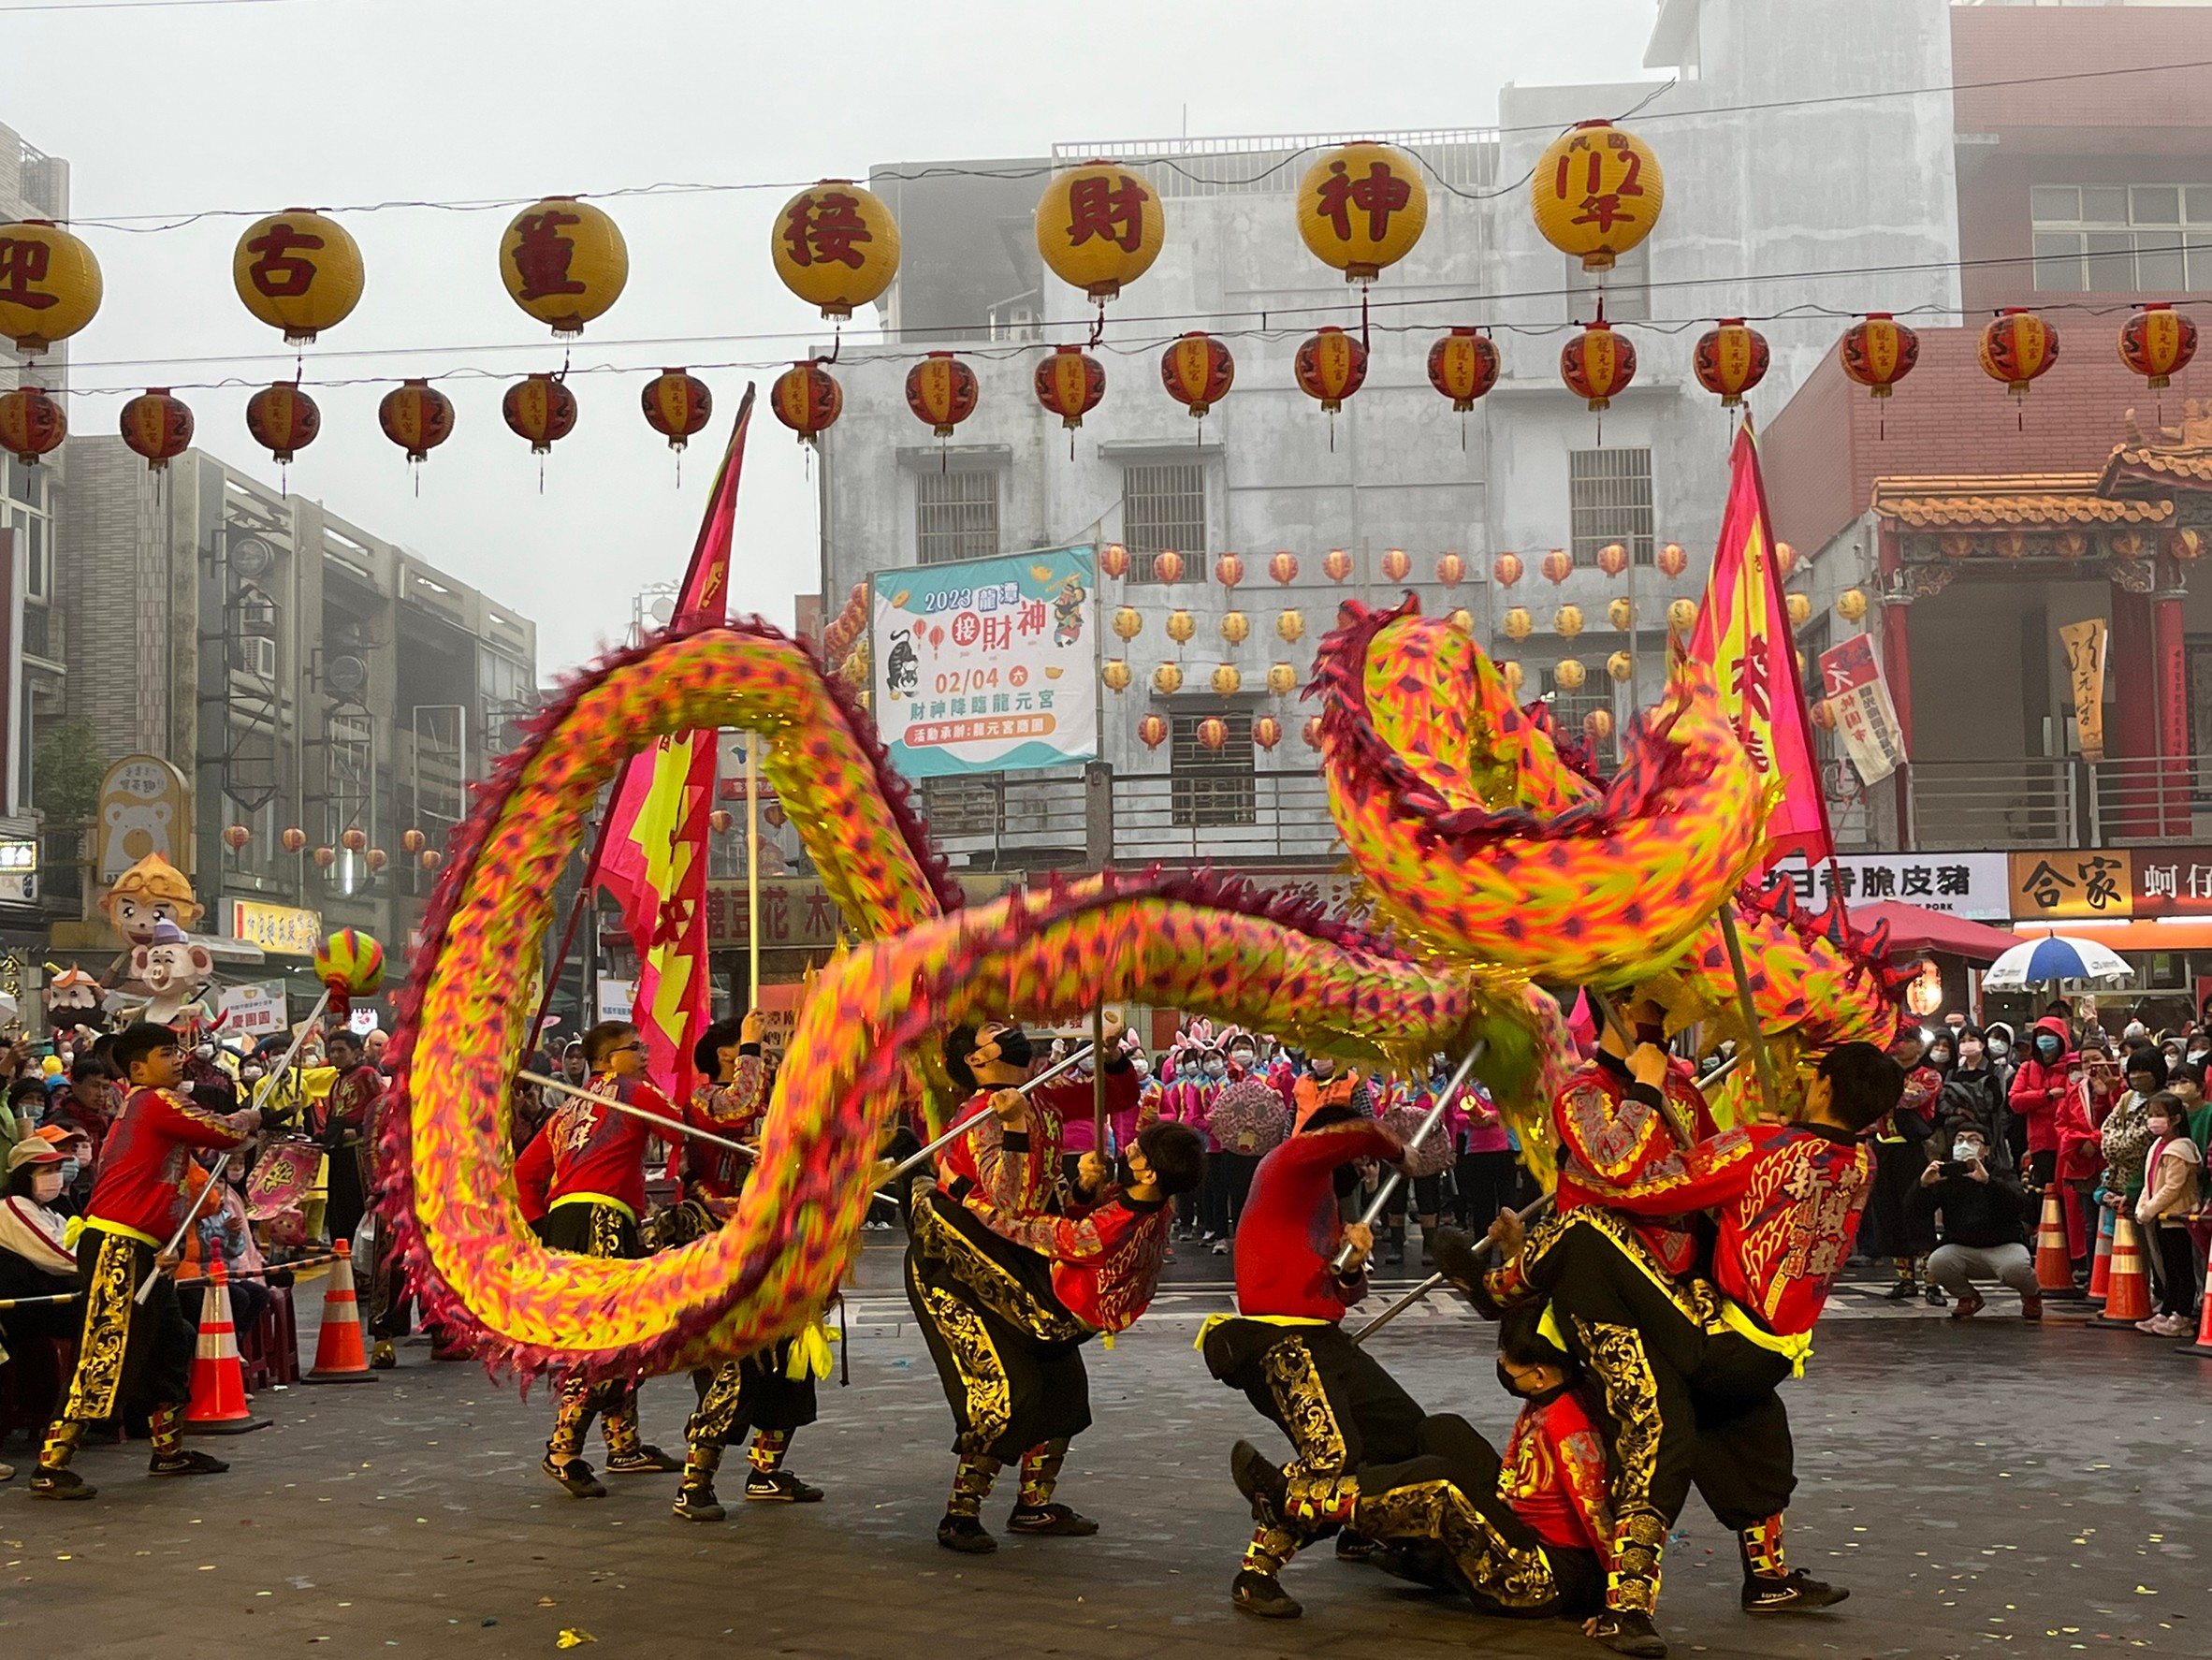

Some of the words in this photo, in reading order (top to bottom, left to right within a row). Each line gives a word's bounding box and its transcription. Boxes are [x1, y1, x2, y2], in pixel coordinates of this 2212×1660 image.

[1569, 133, 1629, 153] 民國
[1556, 151, 1643, 198] 112
[1066, 175, 1149, 253] 財
[1317, 161, 1411, 241] 神
[1571, 194, 1635, 233] 年
[783, 192, 873, 269] 接
[247, 223, 325, 298] 古
[924, 588, 972, 612] 2023
[979, 581, 1020, 612] 龍潭
[953, 600, 1046, 652] 接財神
[936, 667, 998, 694] 02/04
[910, 690, 1055, 721] 財神降臨龍元宮
[2022, 856, 2122, 910] 合家
[1926, 903, 1954, 911] PORK
